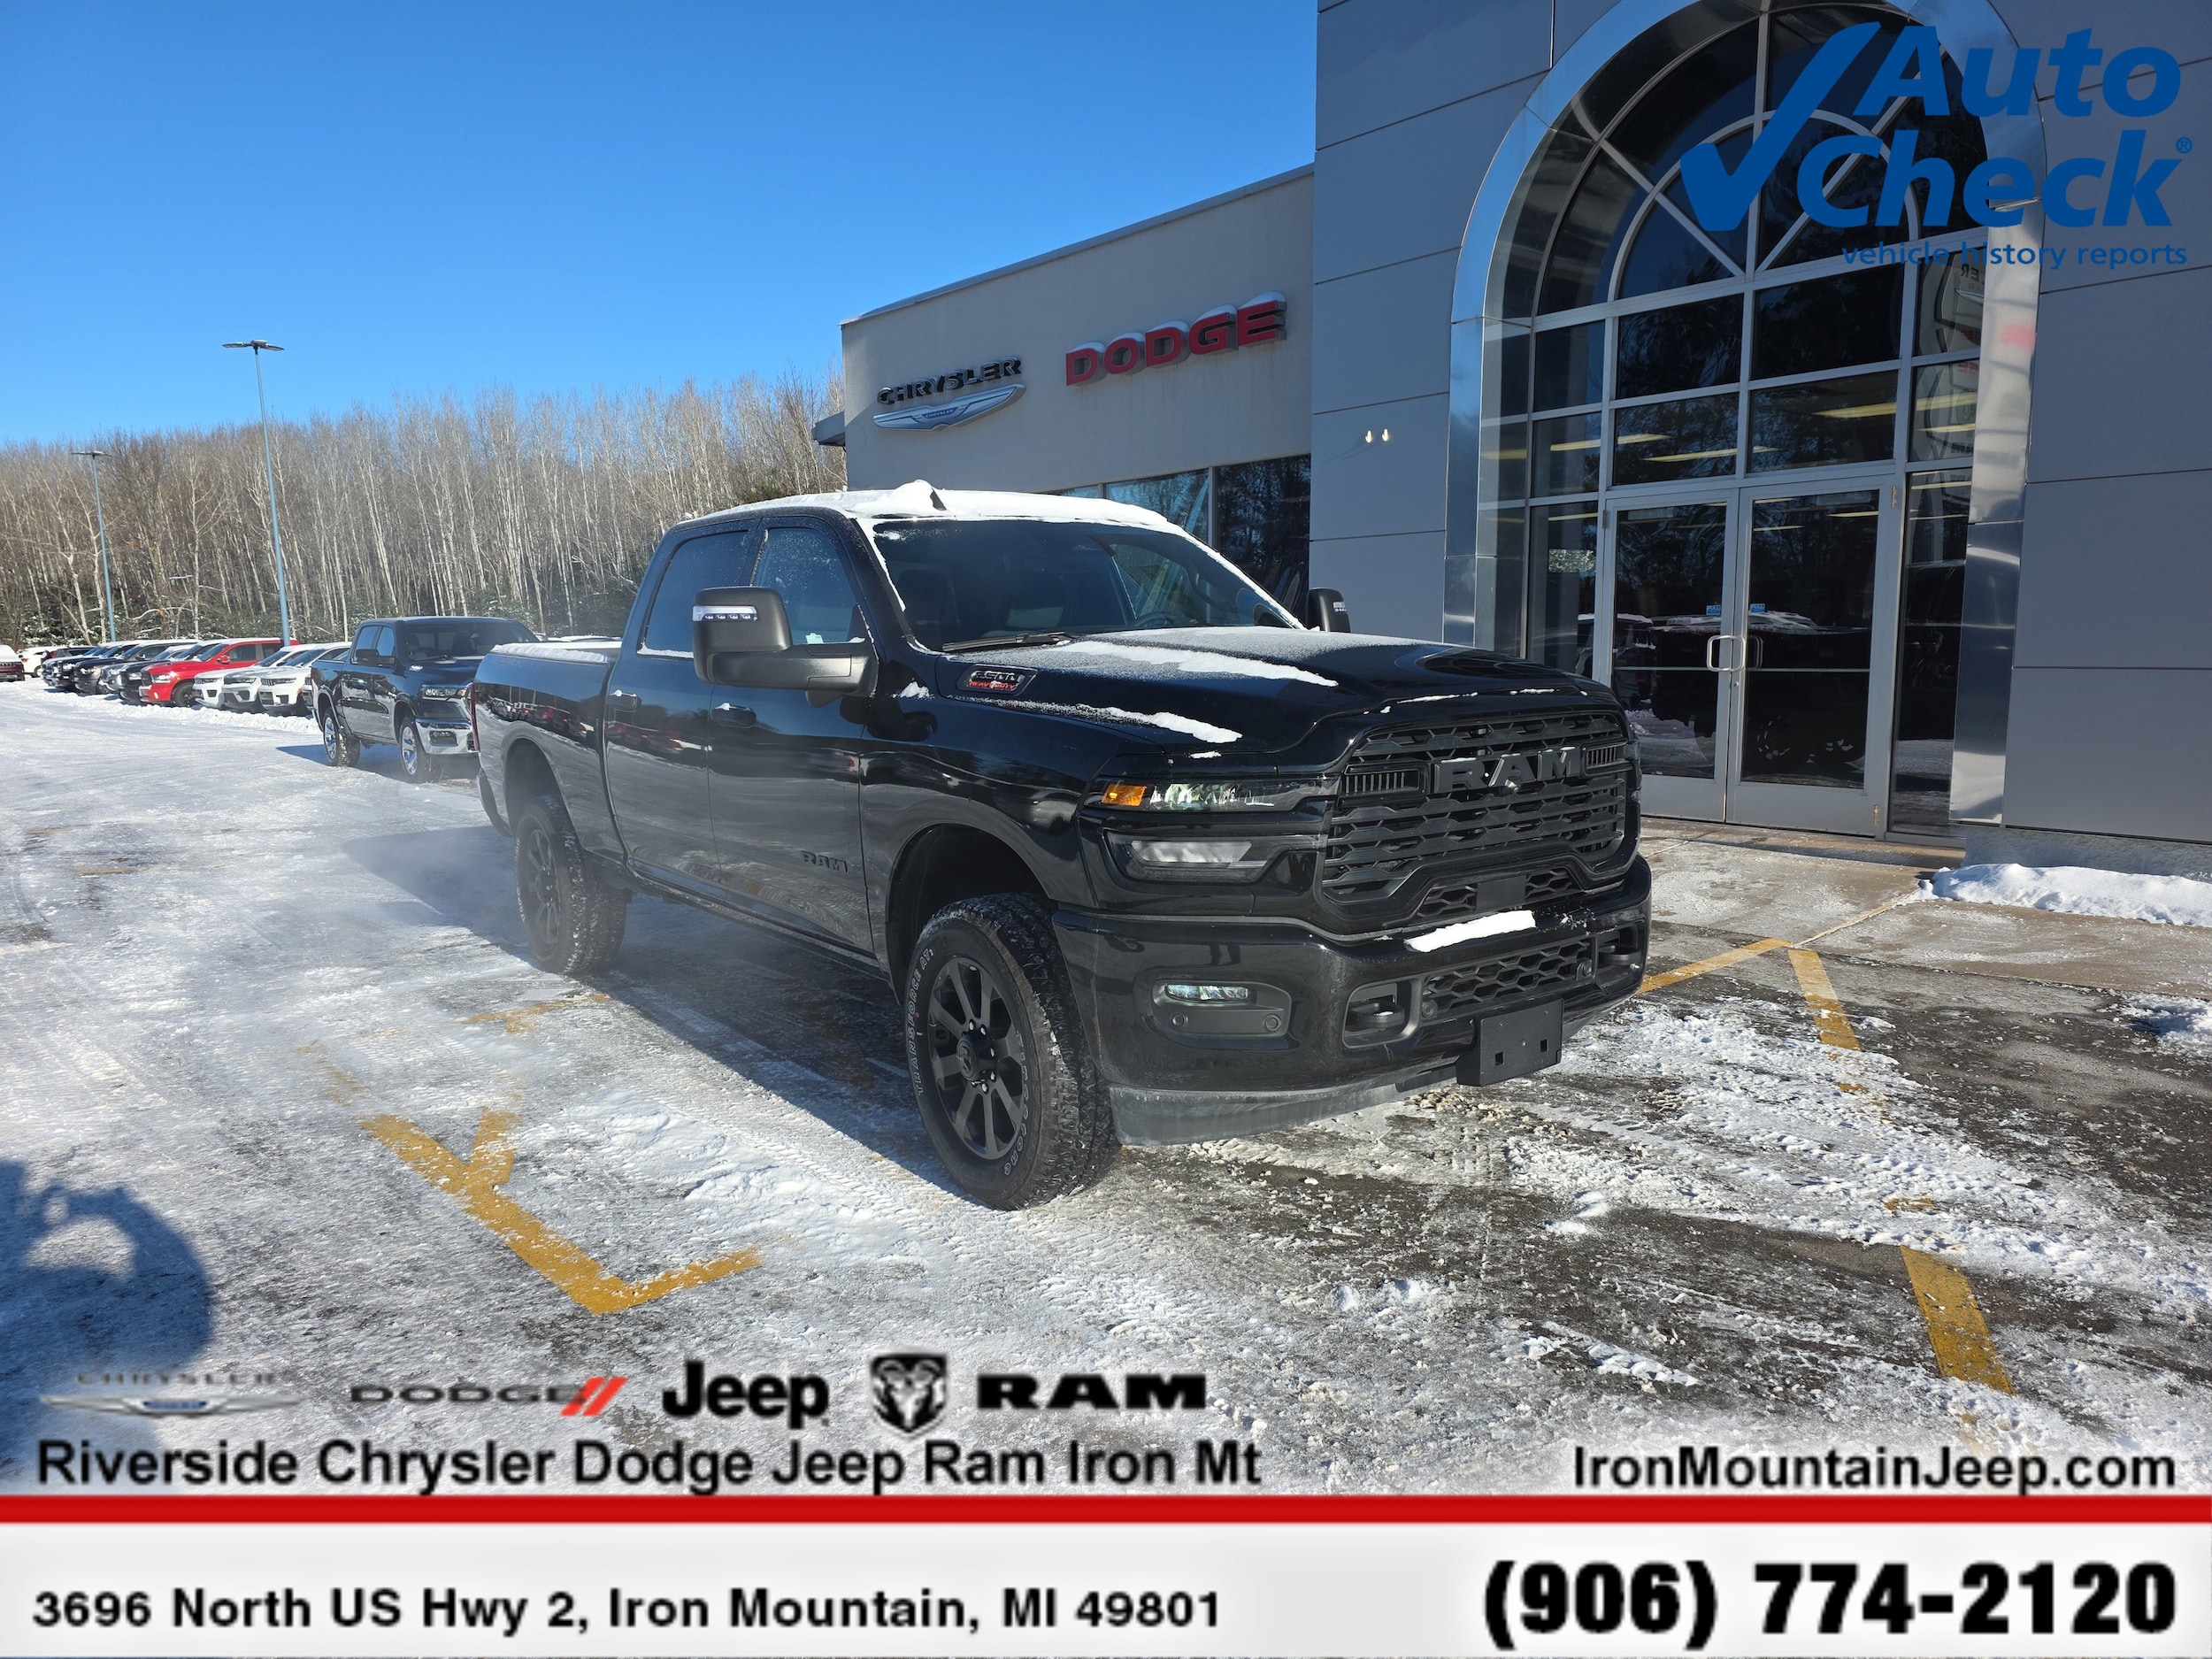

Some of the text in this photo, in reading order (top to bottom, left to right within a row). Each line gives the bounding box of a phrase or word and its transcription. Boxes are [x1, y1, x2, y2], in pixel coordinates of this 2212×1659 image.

[1065, 297, 1286, 387] DODGE
[877, 356, 1022, 404] CHRYSLER
[1433, 747, 1582, 794] RAM
[800, 850, 849, 873] RAM
[907, 968, 925, 1096] TRANSFORCE
